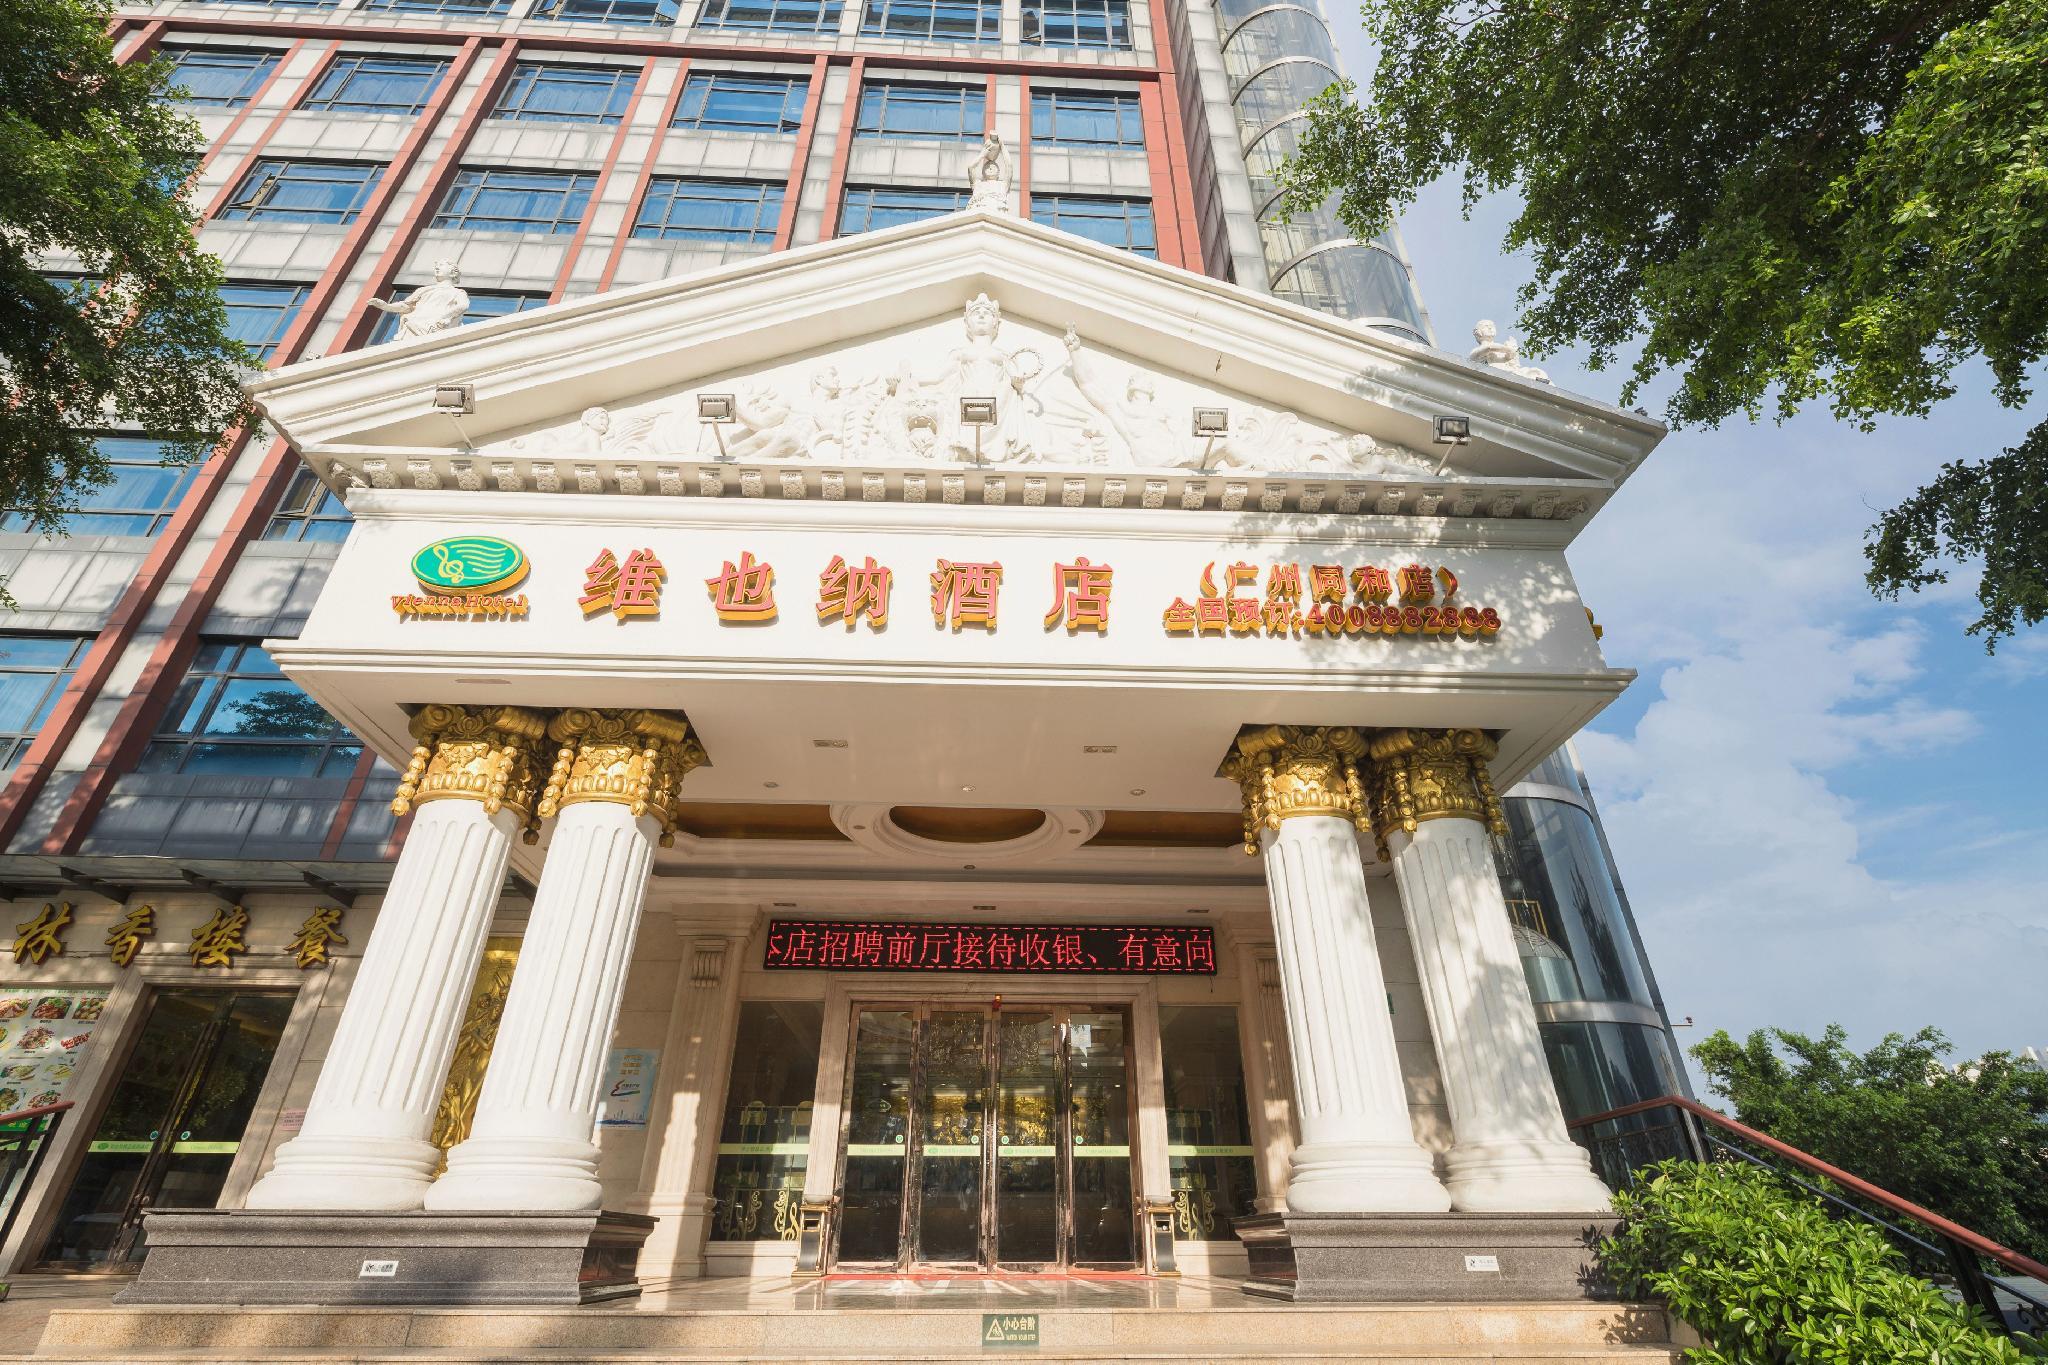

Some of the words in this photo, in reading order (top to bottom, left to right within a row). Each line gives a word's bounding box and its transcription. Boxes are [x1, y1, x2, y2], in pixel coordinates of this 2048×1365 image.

[577, 547, 1113, 630] 维也纳酒店
[1003, 1316, 1036, 1331] 小心台阶
